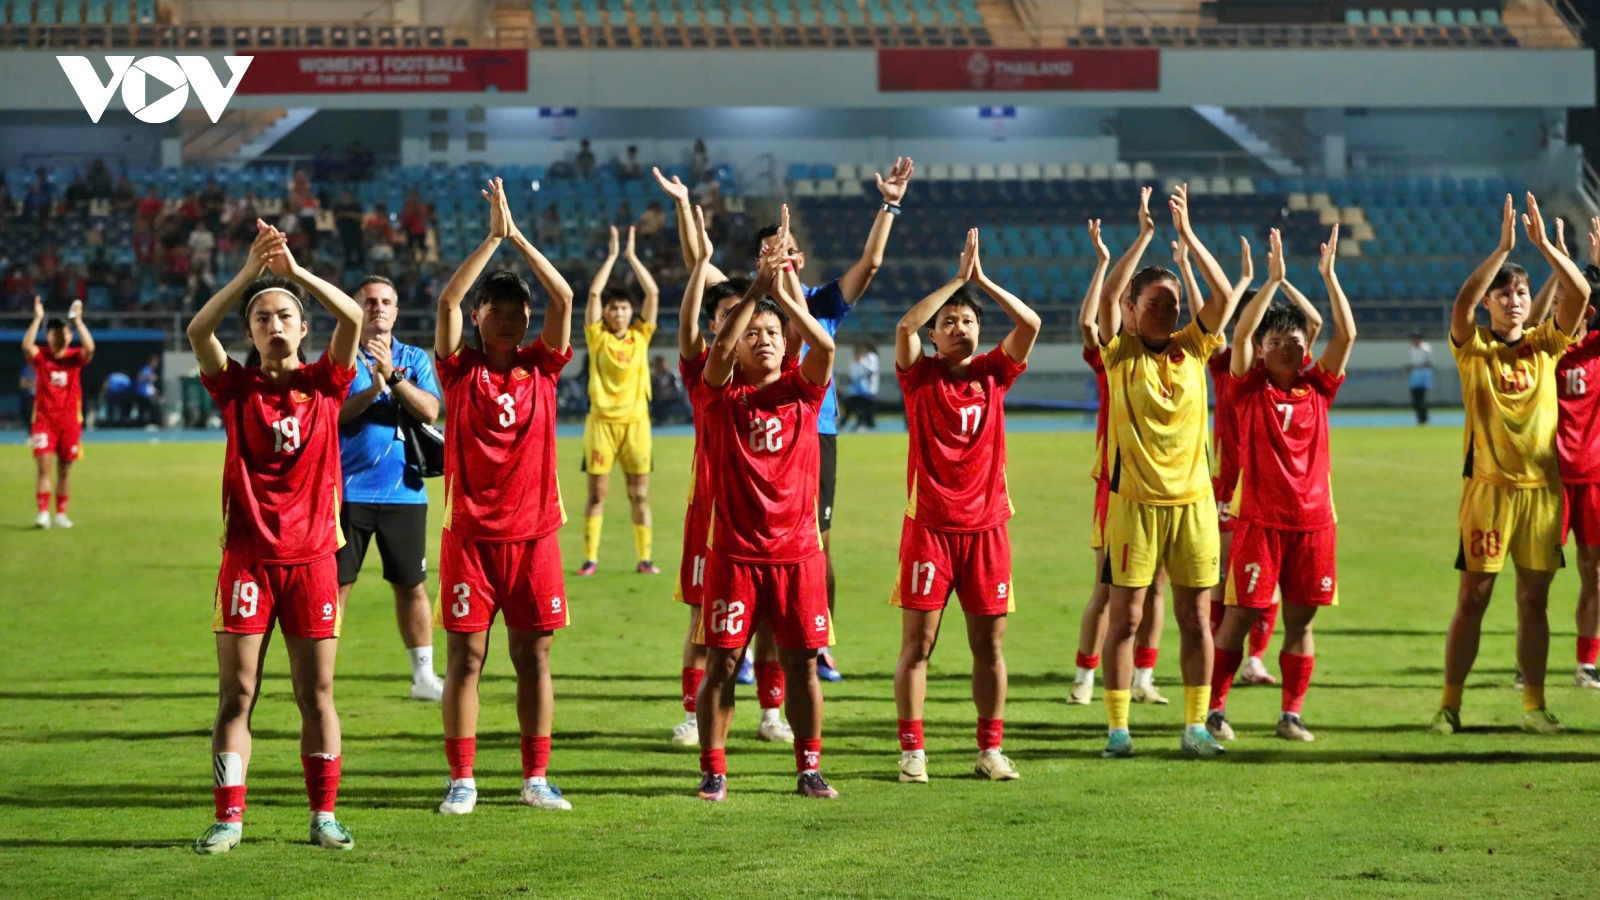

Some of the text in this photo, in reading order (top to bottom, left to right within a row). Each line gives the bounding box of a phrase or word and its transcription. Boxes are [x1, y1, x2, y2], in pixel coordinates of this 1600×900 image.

[299, 56, 468, 72] WOMEN'S FOOTBALL
[994, 61, 1074, 76] THAILAND
[1565, 367, 1587, 395] 16
[497, 393, 516, 428] 3
[960, 405, 982, 436] 17
[1277, 403, 1293, 432] 7
[272, 416, 301, 453] 19
[749, 416, 783, 453] 22
[1121, 543, 1129, 573] 1
[1471, 529, 1501, 558] 20
[911, 560, 936, 596] 17
[1244, 562, 1261, 593] 7
[230, 580, 259, 618] 19
[451, 583, 470, 618] 3
[711, 598, 745, 635] 22
